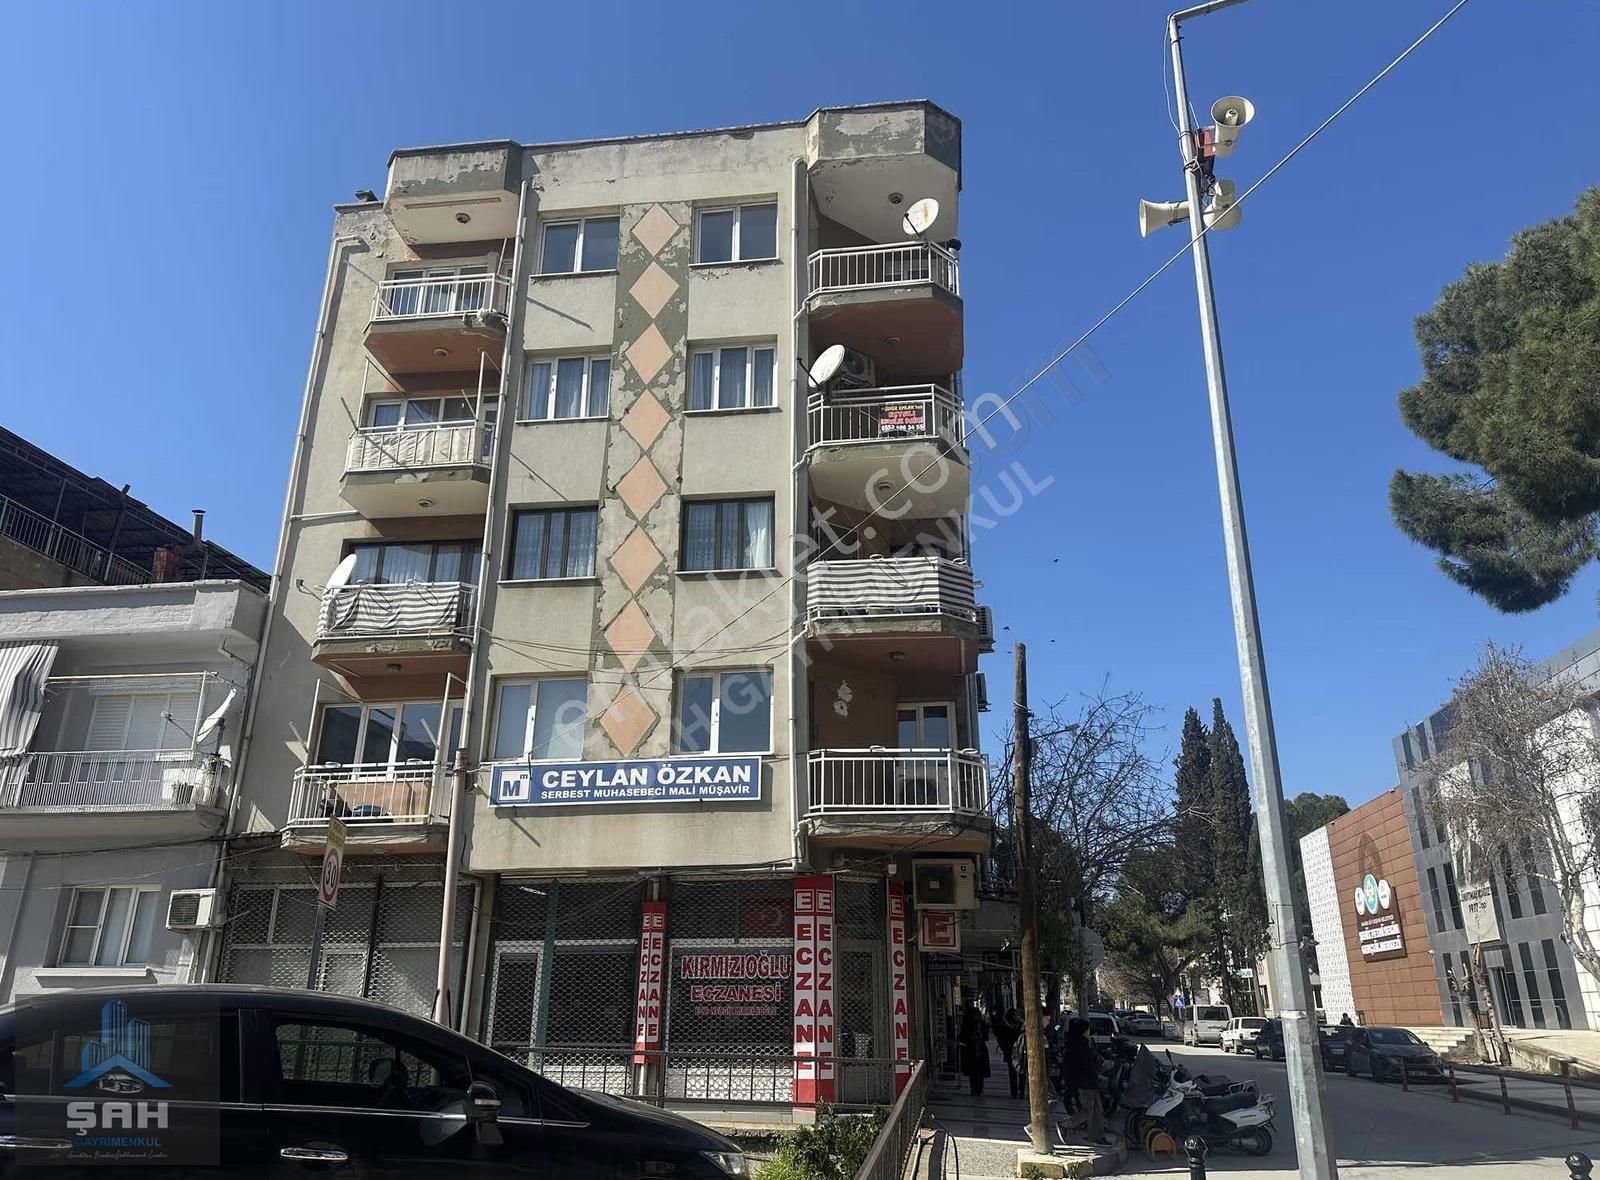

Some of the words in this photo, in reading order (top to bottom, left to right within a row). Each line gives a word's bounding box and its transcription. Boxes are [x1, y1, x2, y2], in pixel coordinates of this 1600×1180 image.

[542, 767, 648, 789] CEYLAN
[657, 764, 751, 785] ÖZKAN
[541, 790, 591, 800] SERBEST
[593, 786, 666, 798] MUHASEBECİ
[669, 785, 696, 797] MALİ
[699, 784, 750, 798] MÜŞAVİR
[326, 861, 337, 888] 30
[796, 891, 814, 909] E
[818, 891, 832, 909] E
[928, 914, 950, 944] E
[681, 950, 793, 979] KIRMIZIOĞLU
[637, 938, 649, 1037] ECZANE
[648, 938, 662, 1037] ECZANE
[690, 981, 782, 1002] ECZANESİ
[796, 923, 814, 1070] ECZANE
[818, 923, 833, 1070] ECZANE
[892, 927, 908, 1060] ECZANE
